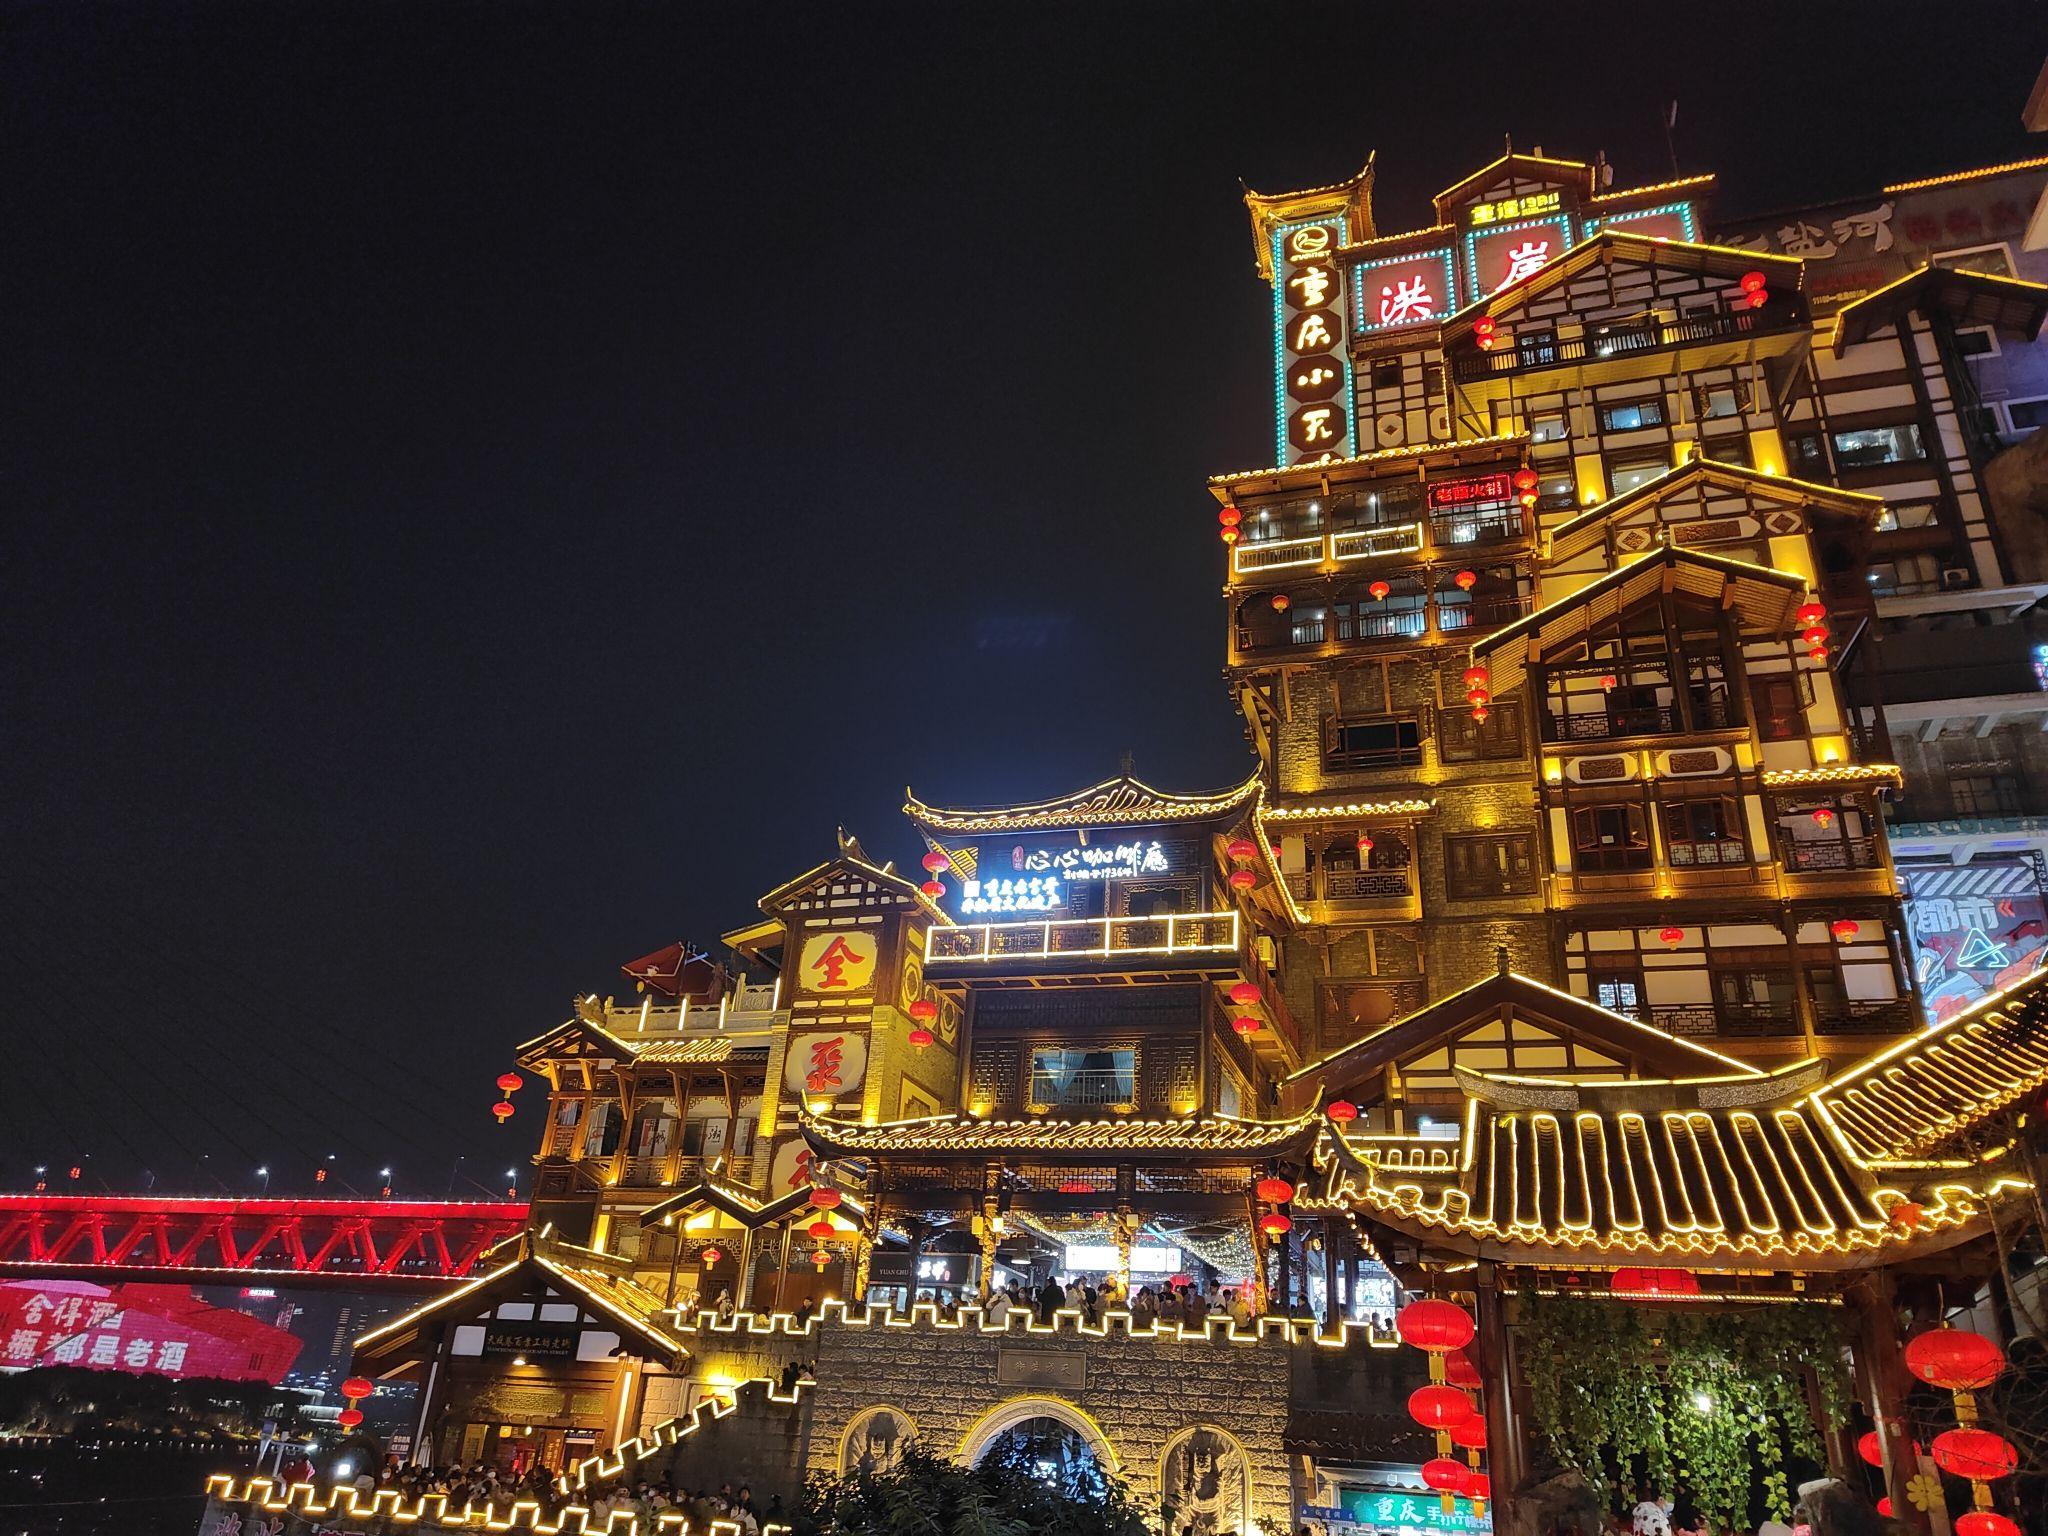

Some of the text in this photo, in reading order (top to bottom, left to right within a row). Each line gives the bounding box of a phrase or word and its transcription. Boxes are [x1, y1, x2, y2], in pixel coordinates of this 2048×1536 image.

[1290, 266, 1335, 463] 重庆小天
[21, 1293, 124, 1330] 舍得酒
[0, 1328, 189, 1372] 瓶都是老酒
